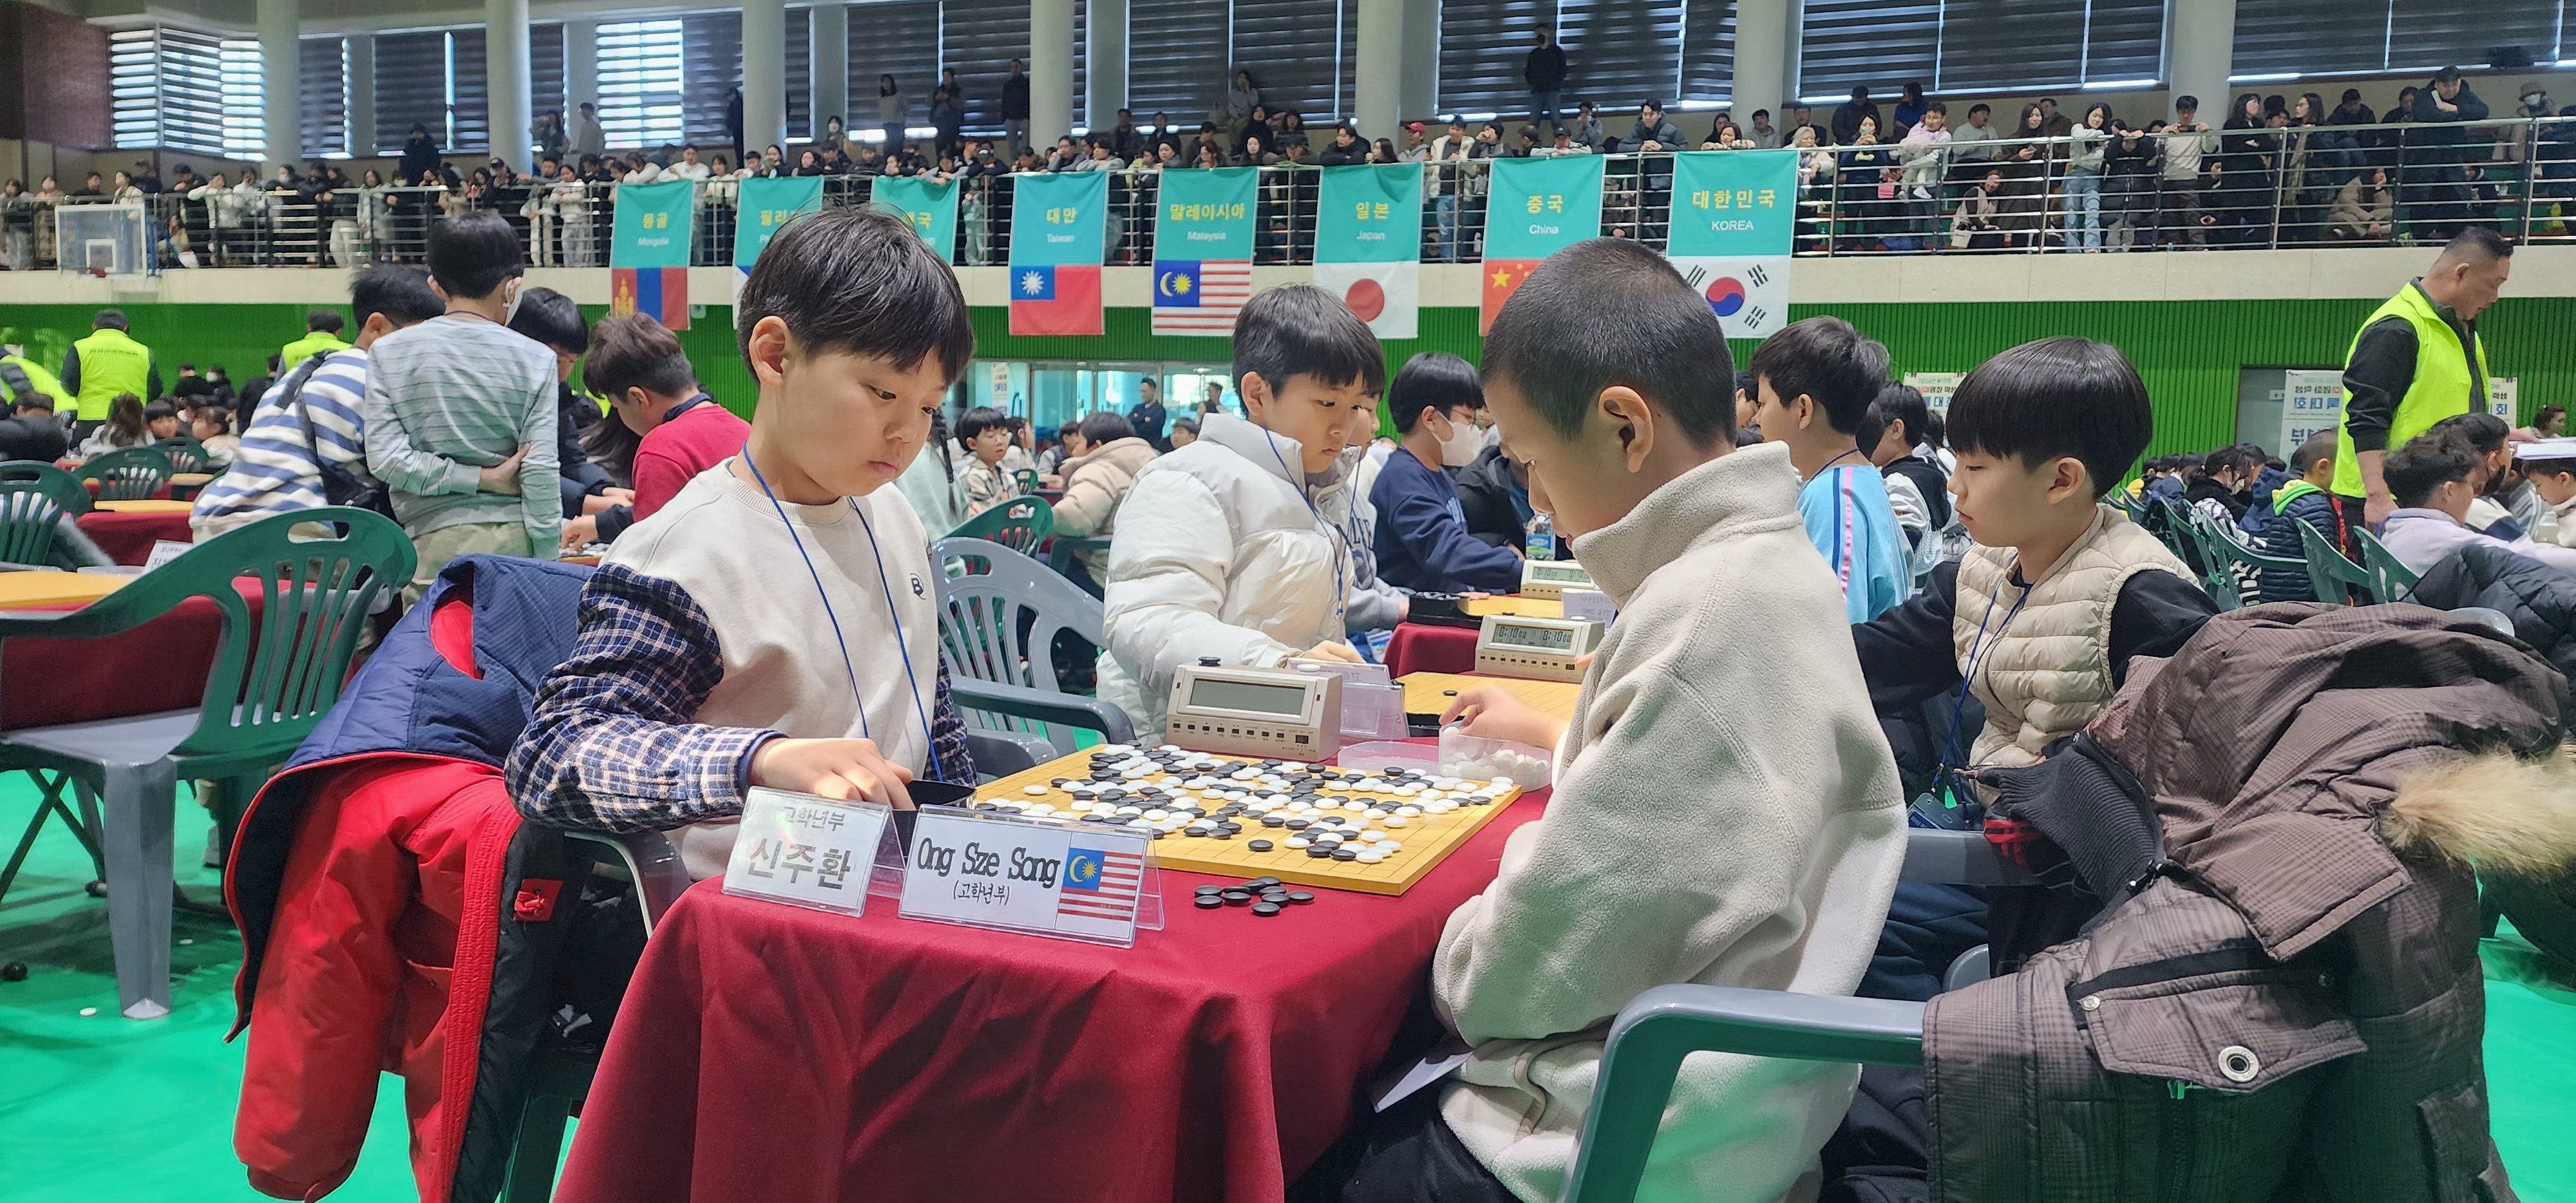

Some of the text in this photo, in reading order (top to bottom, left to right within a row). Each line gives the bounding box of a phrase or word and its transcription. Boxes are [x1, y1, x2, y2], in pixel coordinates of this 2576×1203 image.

[1526, 194, 1564, 214] 중국
[1691, 189, 1776, 209] 대한민국
[1046, 206, 1077, 224] 대만
[1170, 202, 1245, 221] 말레이시아
[1355, 201, 1390, 220] 일본
[1529, 223, 1559, 234] China
[1711, 220, 1754, 231] KOREA
[1046, 233, 1075, 243] Taiwan
[1187, 231, 1227, 242] Malaysia
[1356, 231, 1386, 242] Japan
[783, 806, 846, 831] 고학년부
[748, 838, 851, 890] 신주환
[917, 837, 956, 877] Ong
[961, 842, 1000, 877] Sze
[953, 880, 1010, 905] (고학년부)
